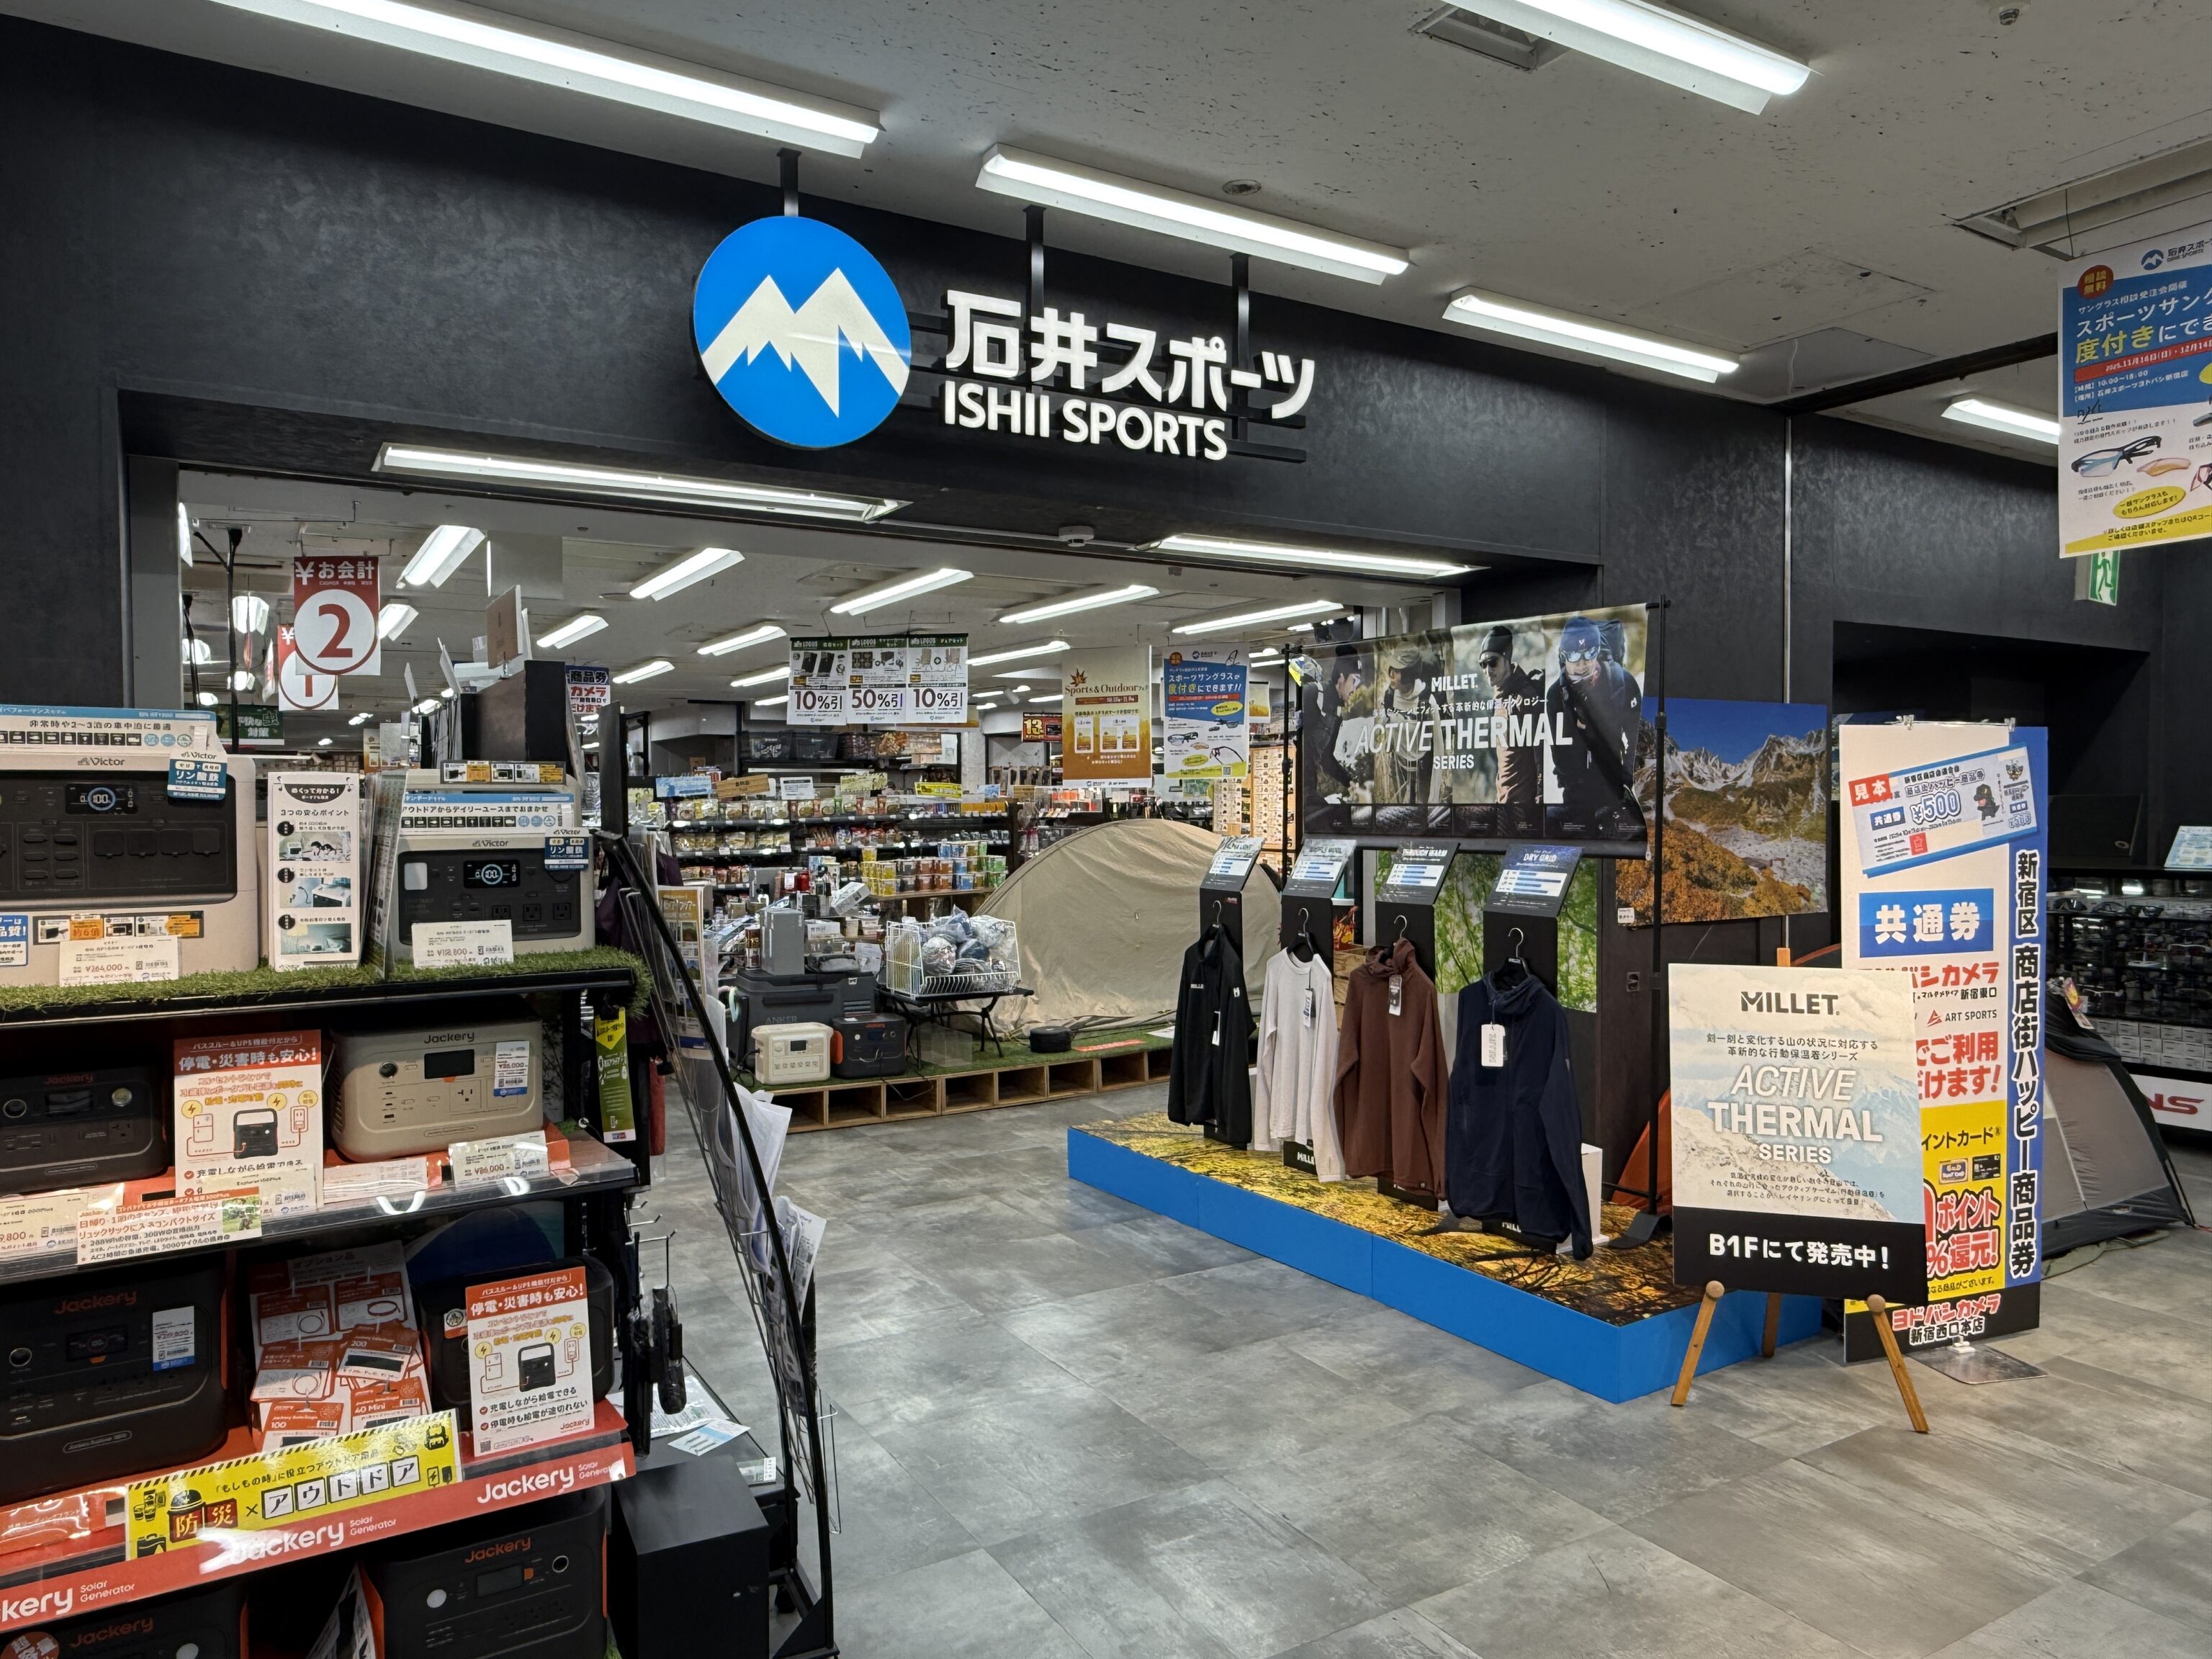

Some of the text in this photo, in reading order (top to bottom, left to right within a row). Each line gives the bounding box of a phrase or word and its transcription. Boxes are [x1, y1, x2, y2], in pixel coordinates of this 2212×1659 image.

[945, 289, 1316, 420] 石井スポーツ
[945, 380, 1228, 462] ISHII SPORTS
[318, 560, 375, 580] お会計
[317, 603, 354, 658] 2
[570, 670, 608, 684] 商品券
[1169, 672, 1241, 683] スポーツサングラスが
[570, 686, 607, 697] カメラ
[794, 690, 842, 711] 10%引
[851, 688, 903, 709] 50%引
[913, 688, 963, 709] 10%引
[1354, 711, 1573, 755] ACTIVE THERMAL
[91, 757, 125, 767] Victor
[191, 752, 217, 760] Victor
[1432, 754, 1475, 770] SERIES
[1853, 778, 1888, 802] 見本
[1910, 788, 1962, 826] ¥500
[2017, 851, 2041, 938] 新宿区
[1874, 902, 1980, 945] 共通券
[85, 963, 123, 973] ¥264,000
[765, 1015, 798, 1024] ANKER
[1945, 1010, 1997, 1022] ART SPORTS
[423, 1031, 475, 1044] Jackery
[179, 1047, 318, 1071] 停電・災害時も安心!
[1730, 1064, 1857, 1102] ACTIVE
[1707, 1101, 1884, 1143] THERMAL
[2013, 944, 2041, 1278] 商店街ハッピー商品券
[1758, 1142, 1833, 1164] SERIES
[1936, 1190, 2000, 1233] ポイント
[1709, 1233, 1889, 1270] B1Fにて発売中!
[54, 1290, 138, 1314] Jackery
[470, 1283, 584, 1316] 停電・災害時も安心!
[1892, 1293, 2002, 1332] ヨドバシカメラ
[1909, 1316, 1986, 1346] 新宿西口本店
[368, 1403, 386, 1412] Mini
[490, 1387, 577, 1413] 充電しながら給電できる
[490, 1400, 588, 1429] 停電時も給電が途切れない
[560, 1418, 590, 1431] Jackery
[578, 1461, 598, 1473] Solar
[477, 1466, 575, 1504] Jackery
[175, 1505, 234, 1539] 防災
[269, 1461, 417, 1514] アウトドア
[349, 1515, 374, 1528] Solar
[349, 1518, 397, 1537] Generator
[464, 1537, 531, 1564] Jackery
[80, 1580, 108, 1593] Solar
[80, 1583, 135, 1603] Generator
[0, 1587, 74, 1622] kery
[70, 1617, 154, 1648] Jackery
